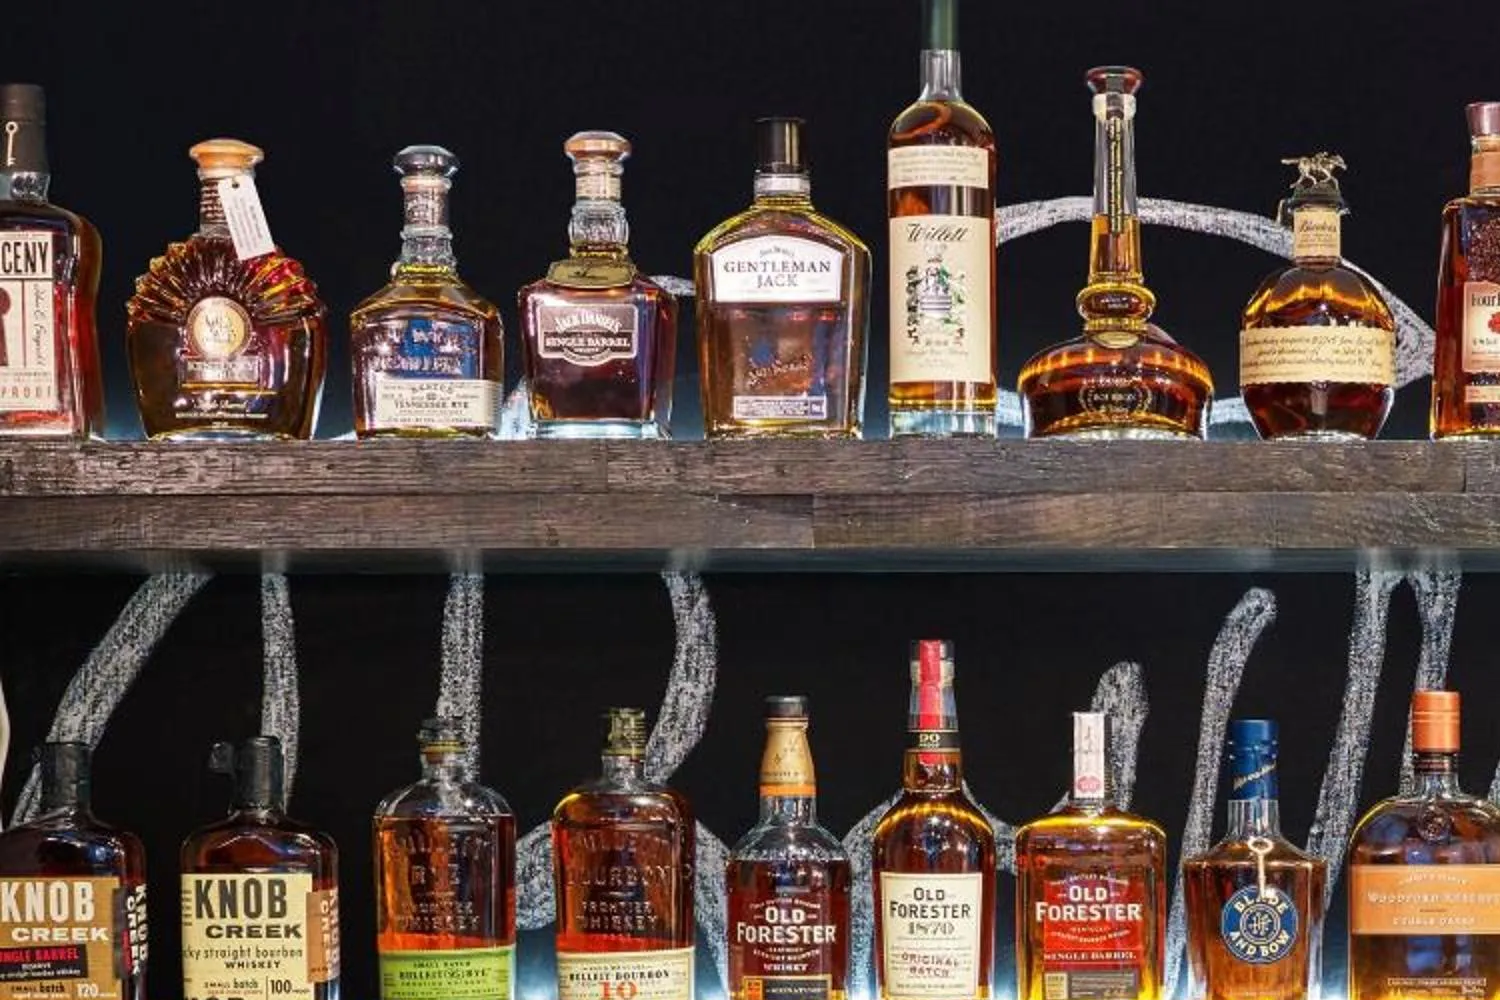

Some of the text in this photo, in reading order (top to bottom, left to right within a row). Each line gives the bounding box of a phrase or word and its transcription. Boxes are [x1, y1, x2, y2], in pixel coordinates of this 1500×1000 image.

[906, 223, 969, 243] Willett
[723, 260, 832, 274] GENTLEMAN
[756, 274, 799, 288] JACK
[1471, 292, 1496, 307] Four
[545, 336, 631, 347] SINGLE BARREL
[194, 878, 288, 920] KNOB
[912, 887, 946, 901] OLD
[1069, 885, 1108, 902] OLD
[0, 880, 96, 924] KNOB
[889, 901, 971, 919] FORESTER
[764, 905, 806, 924] OLD
[1035, 901, 1144, 922] FORESTER
[11, 927, 110, 943] CREEK
[205, 924, 304, 940] CREEK
[736, 921, 838, 944] FORESTER
[907, 921, 956, 936] 1870
[1229, 929, 1290, 957] AND BOW
[203, 945, 251, 961] straight
[255, 944, 304, 959] bourbon
[901, 951, 961, 967] ORIGINAL
[1091, 950, 1137, 960] BARREL
[224, 960, 281, 969] WHISKEY
[615, 968, 670, 981] BOURBON
[233, 978, 259, 989] batch
[270, 979, 293, 995] 100
[600, 980, 639, 1000] 10
